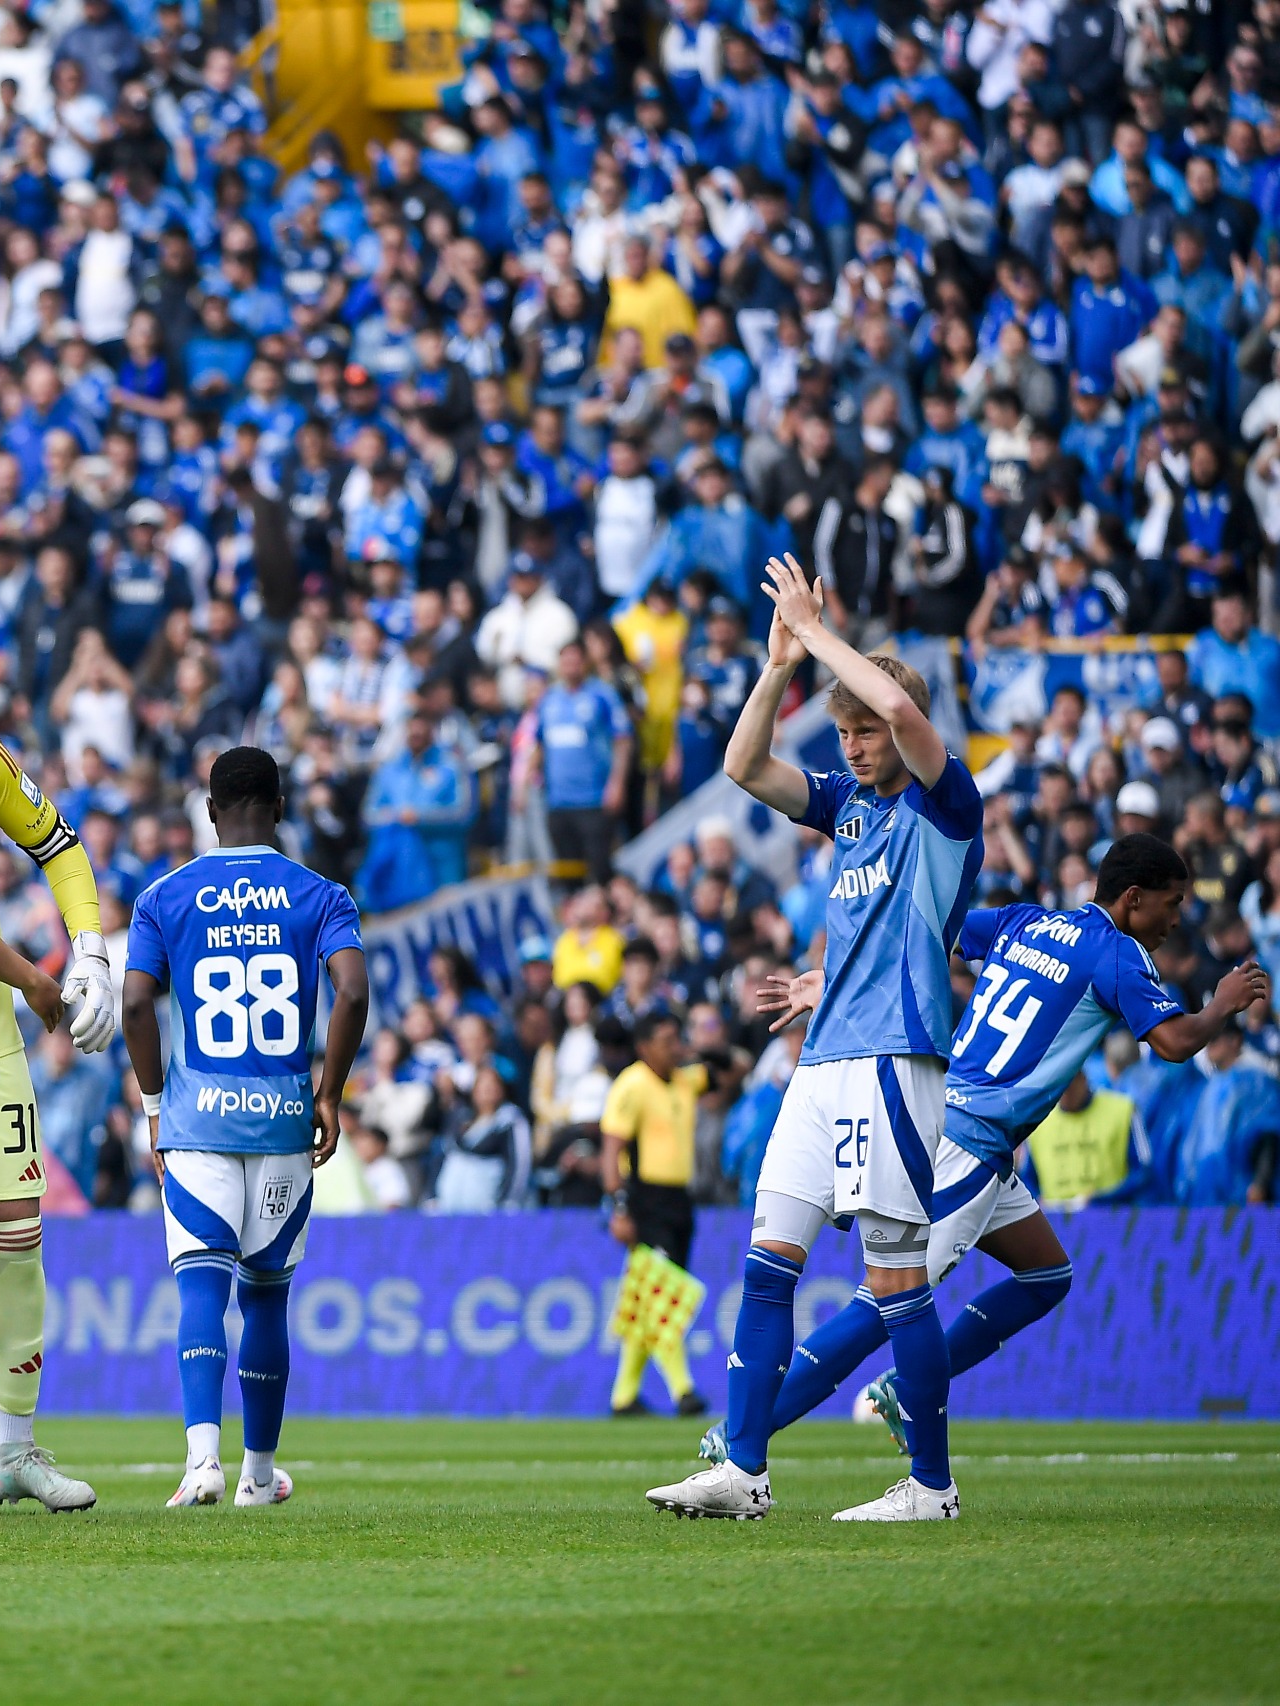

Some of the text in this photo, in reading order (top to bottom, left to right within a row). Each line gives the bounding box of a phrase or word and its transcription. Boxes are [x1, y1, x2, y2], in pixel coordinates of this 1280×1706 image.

[206, 923, 281, 949] NEYSER
[193, 953, 300, 1059] 88
[951, 962, 1044, 1078] 34
[196, 1086, 304, 1120] Wplay.co
[1, 1103, 38, 1155] 31
[834, 1118, 870, 1169] 26
